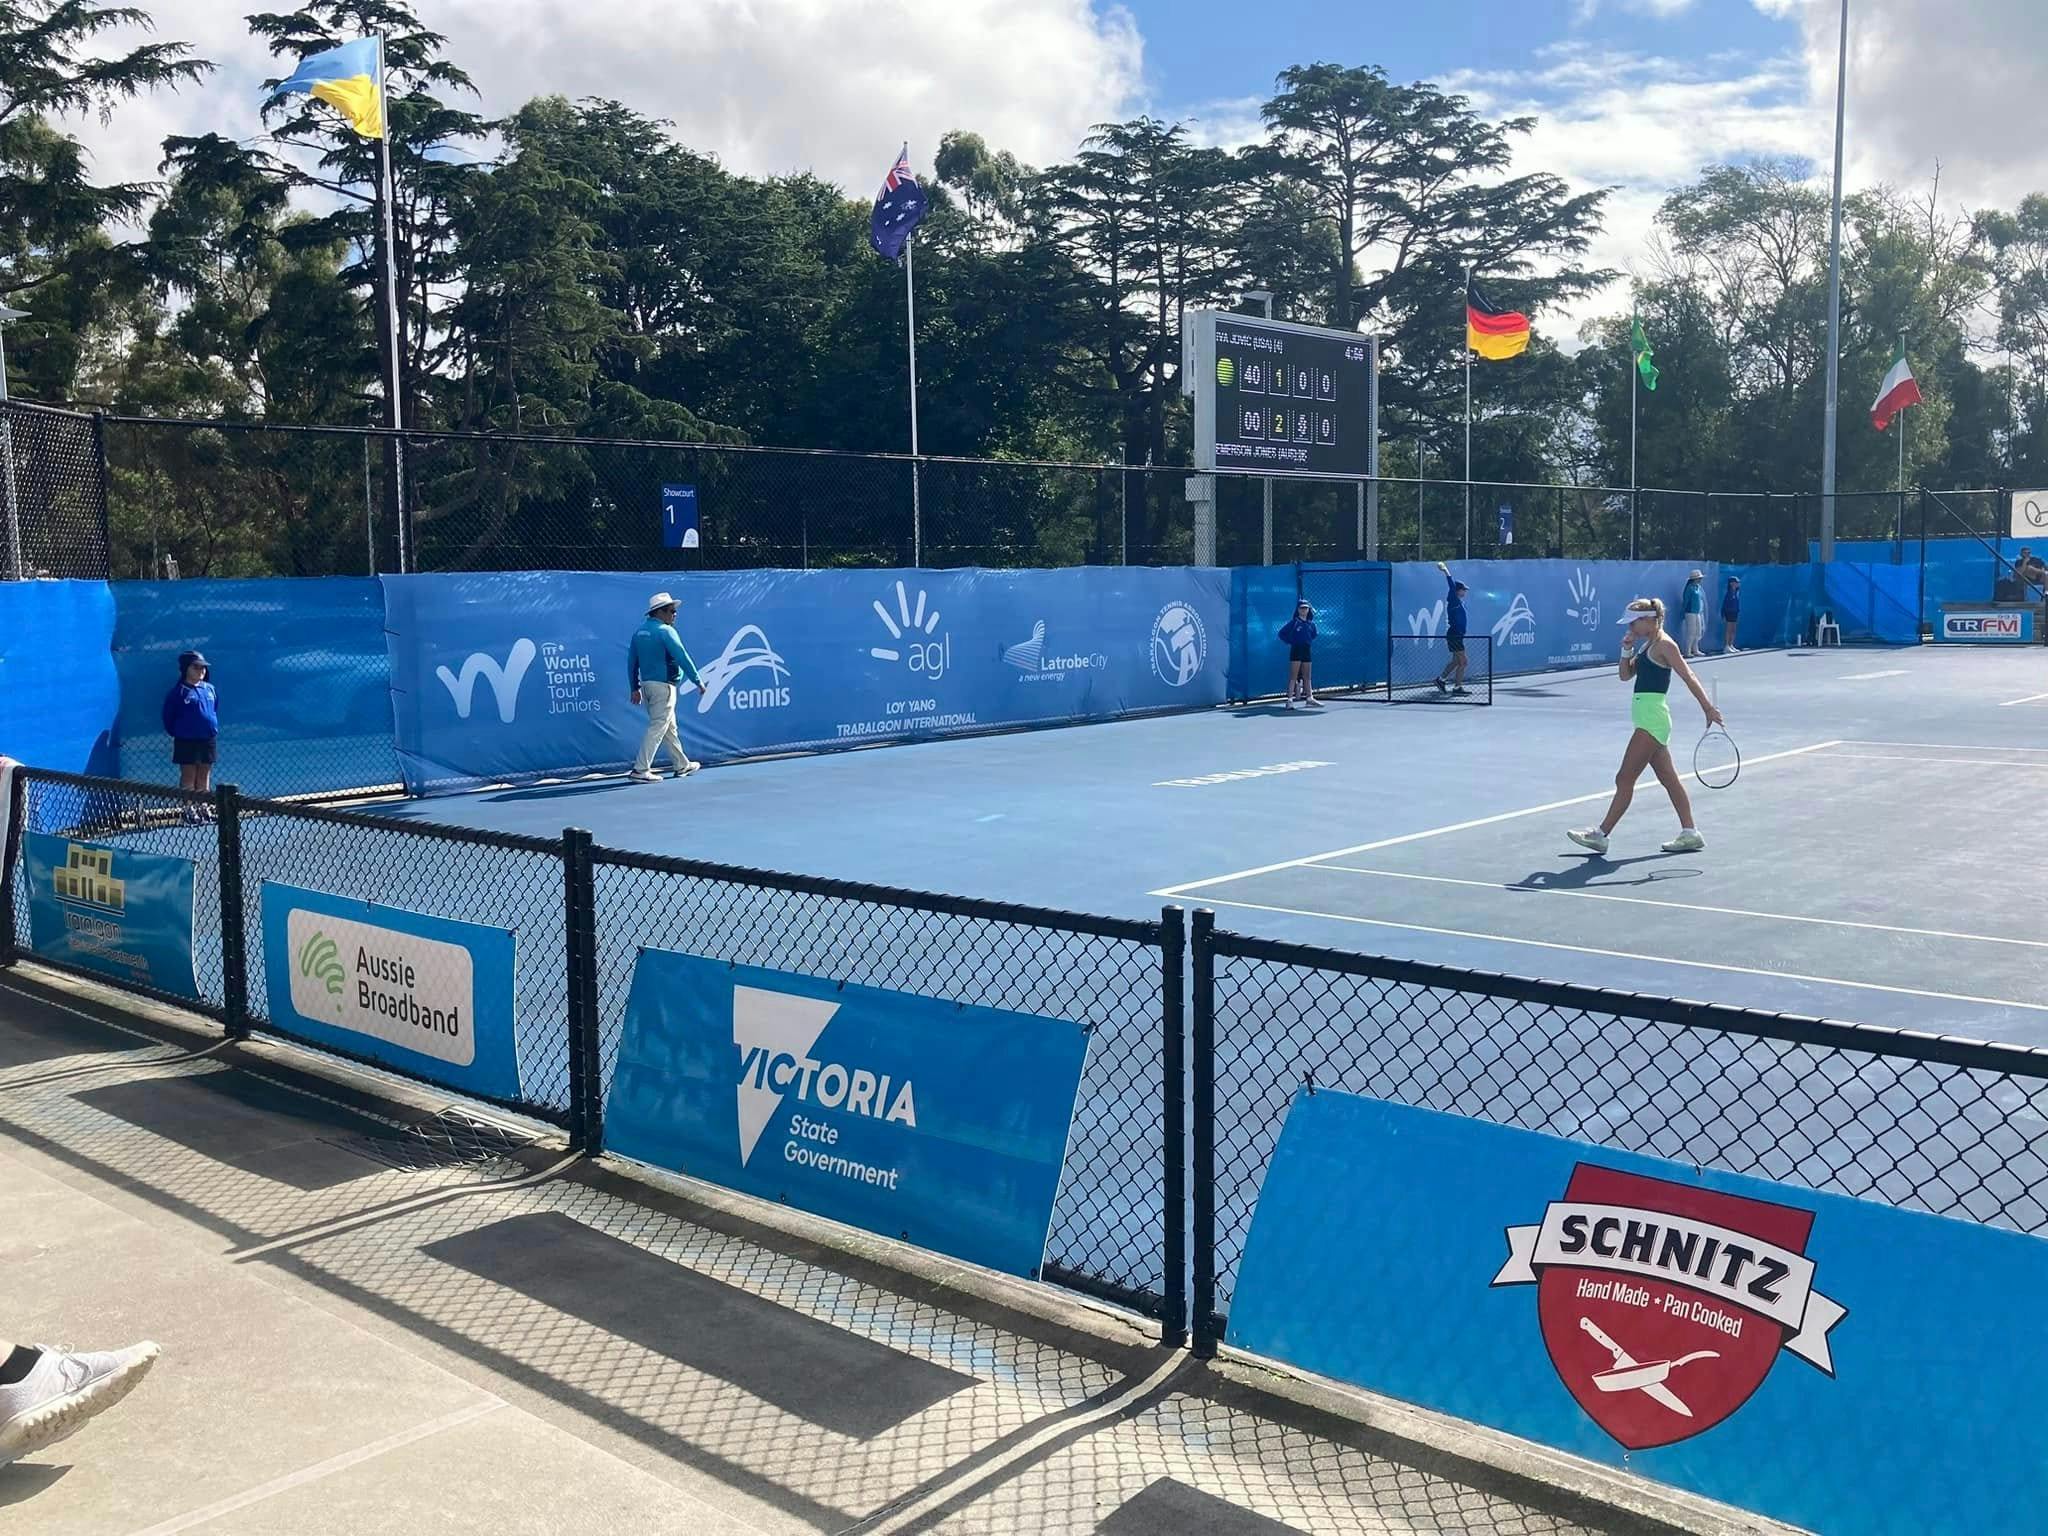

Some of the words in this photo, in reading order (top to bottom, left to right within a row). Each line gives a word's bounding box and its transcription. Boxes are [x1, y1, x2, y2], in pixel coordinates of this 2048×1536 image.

[1244, 364, 1261, 385] 40
[1275, 368, 1282, 387] 1
[1299, 371, 1307, 390] 0
[1322, 374, 1330, 393] 0
[1244, 411, 1261, 431] 00
[1274, 414, 1283, 433] 2
[1322, 418, 1330, 437] 0
[664, 487, 695, 498] Showcourt
[665, 504, 674, 525] 1
[1581, 600, 1601, 632] agl
[1510, 629, 1536, 646] tennis
[543, 654, 590, 670] World
[908, 632, 950, 680] agl
[546, 669, 596, 685] Tennis
[1024, 673, 1040, 682] new
[1041, 671, 1066, 682] energy
[548, 684, 582, 700] Tour
[728, 686, 791, 710] tennis
[549, 699, 601, 715] Juniors
[886, 702, 905, 715] LOY
[908, 699, 936, 713] YANG
[837, 721, 901, 737] TRARALGON
[903, 712, 976, 730] INTERNATIONAL
[357, 946, 415, 989] Aussie
[358, 981, 460, 1037] Broadband
[737, 1046, 917, 1128] VICTORIA
[789, 1114, 839, 1146] State
[784, 1140, 898, 1191] Government
[1559, 1214, 1791, 1305] SCHNITZ
[1576, 1278, 1611, 1301] Hand
[1611, 1282, 1650, 1308] Made
[1663, 1293, 1690, 1318] Pan
[1691, 1301, 1743, 1338] Cooked
